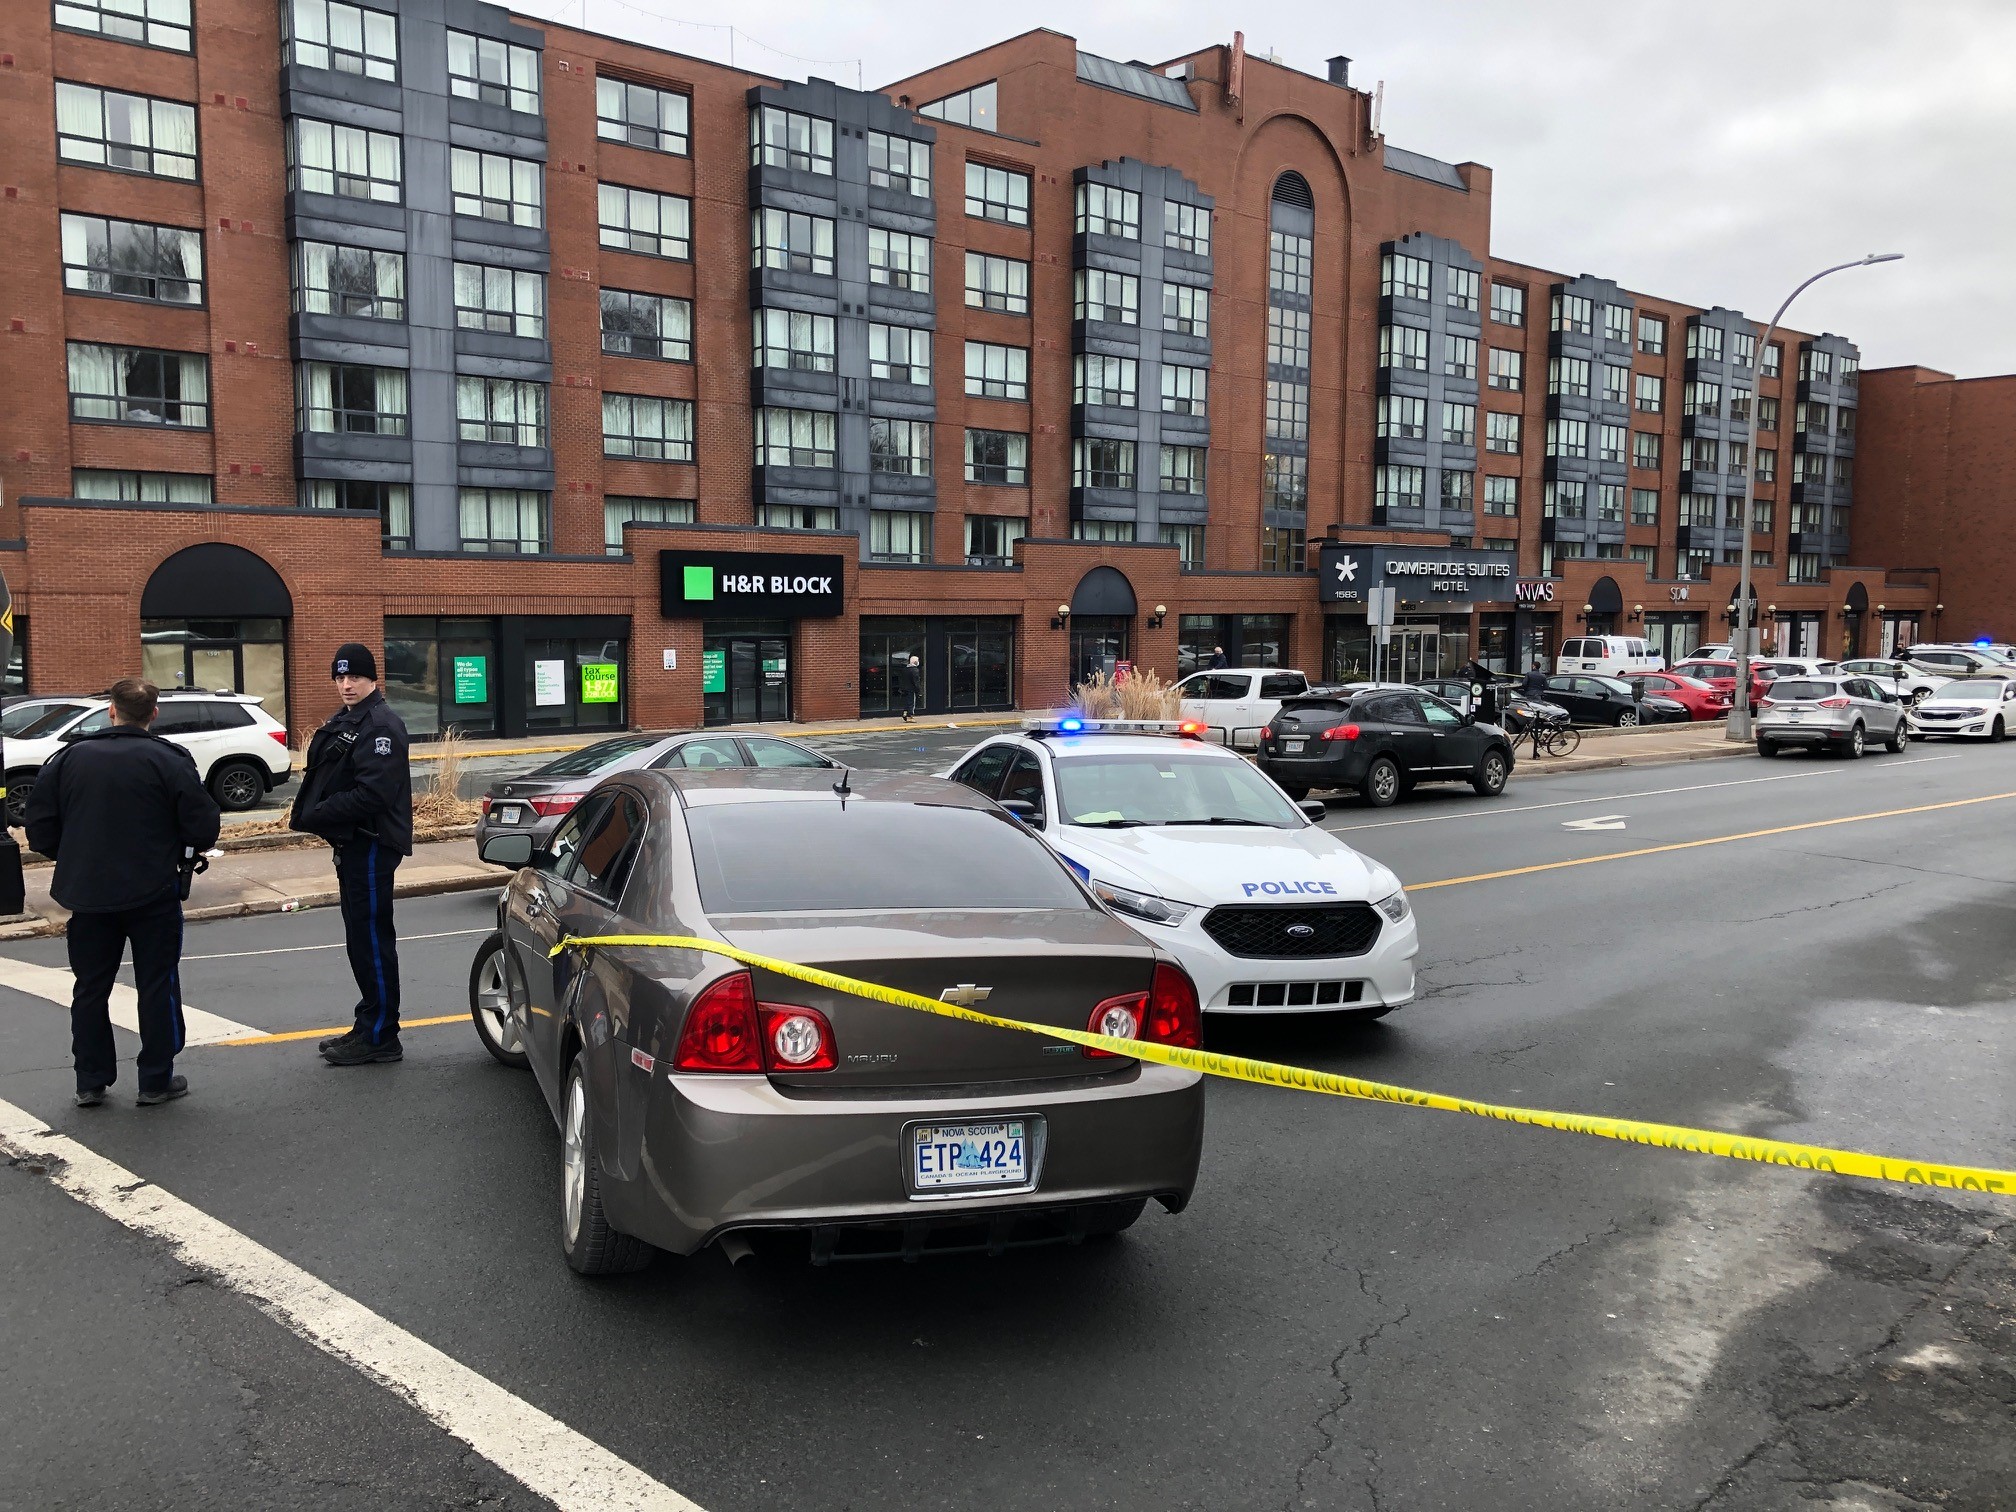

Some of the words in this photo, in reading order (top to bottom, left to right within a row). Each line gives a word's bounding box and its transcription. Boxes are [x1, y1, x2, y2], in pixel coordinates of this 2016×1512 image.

[1385, 561, 1465, 576] CAMBRIDGE
[1466, 563, 1510, 577] SUITES
[722, 575, 766, 593] H&R
[770, 576, 832, 594] BLOCK
[1431, 581, 1470, 592] HOTEL
[1334, 591, 1357, 599] 1583
[1515, 582, 1554, 602] ANVAS
[1669, 585, 1690, 601] spot
[584, 666, 601, 675] tax
[584, 673, 616, 681] course
[585, 680, 616, 692] 1-877
[1241, 881, 1338, 898] POLICE
[941, 1128, 965, 1138] NOVA
[967, 1126, 999, 1136] SCOTIA
[920, 1143, 962, 1173] ETP
[980, 1139, 1022, 1168] 424
